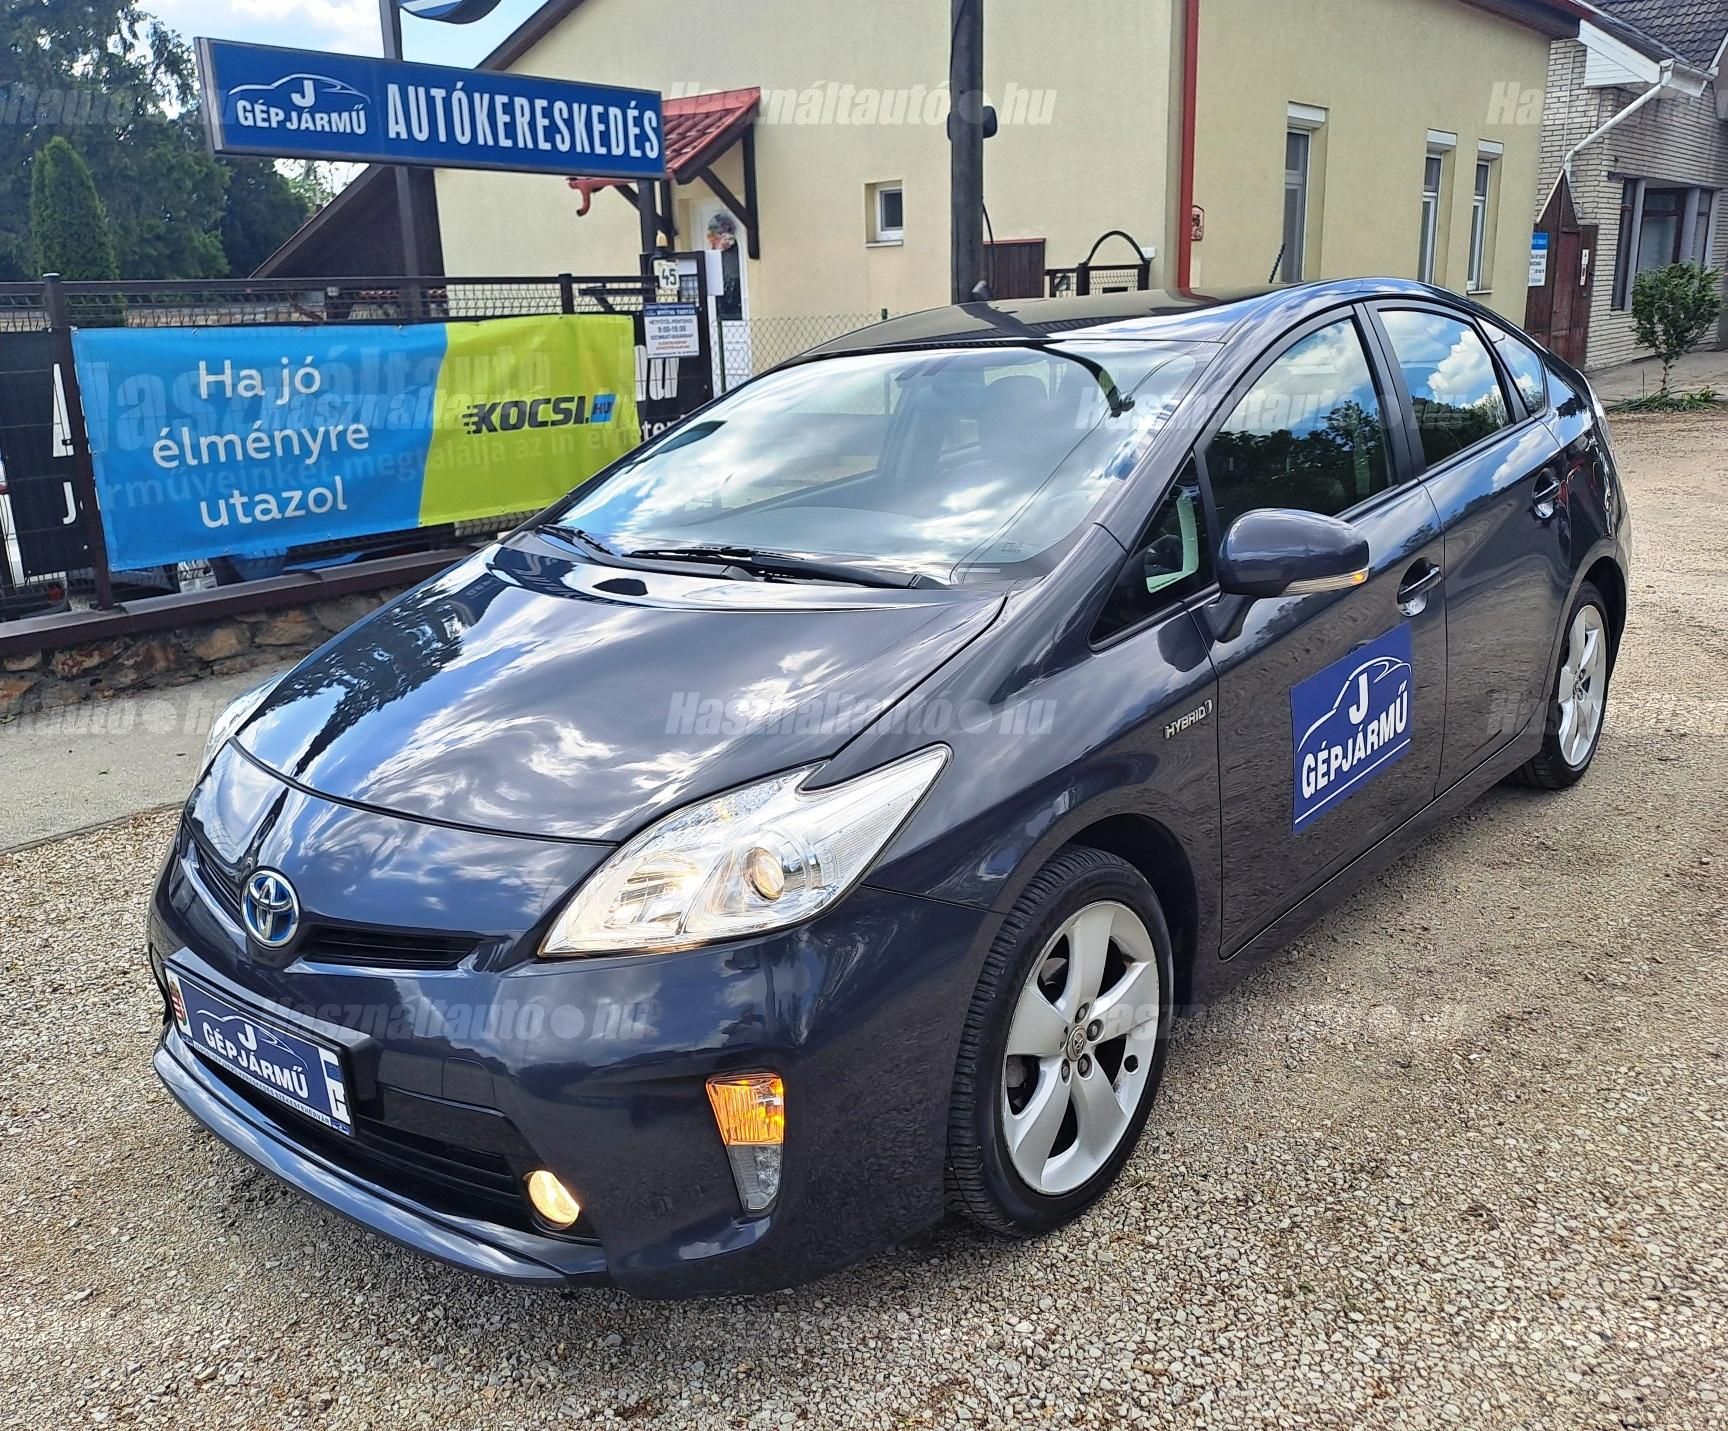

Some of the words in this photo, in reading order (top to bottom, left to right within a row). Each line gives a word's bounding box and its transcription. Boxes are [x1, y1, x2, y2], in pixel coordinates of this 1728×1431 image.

[236, 99, 367, 136] GÉPJÁRMŰ
[290, 80, 317, 108] J
[385, 81, 660, 160] AUTÓKERESKEDÉS
[661, 267, 678, 287] 45
[197, 358, 266, 400] Ha
[275, 354, 321, 406] jó
[152, 419, 370, 469] élményre
[199, 475, 348, 529] utazol
[1164, 704, 1207, 740] HYBRID
[1347, 672, 1369, 725] J
[1301, 679, 1409, 800] GÉPJÁRMŰ
[202, 1021, 309, 1099] GÉPJÁRMŰ
